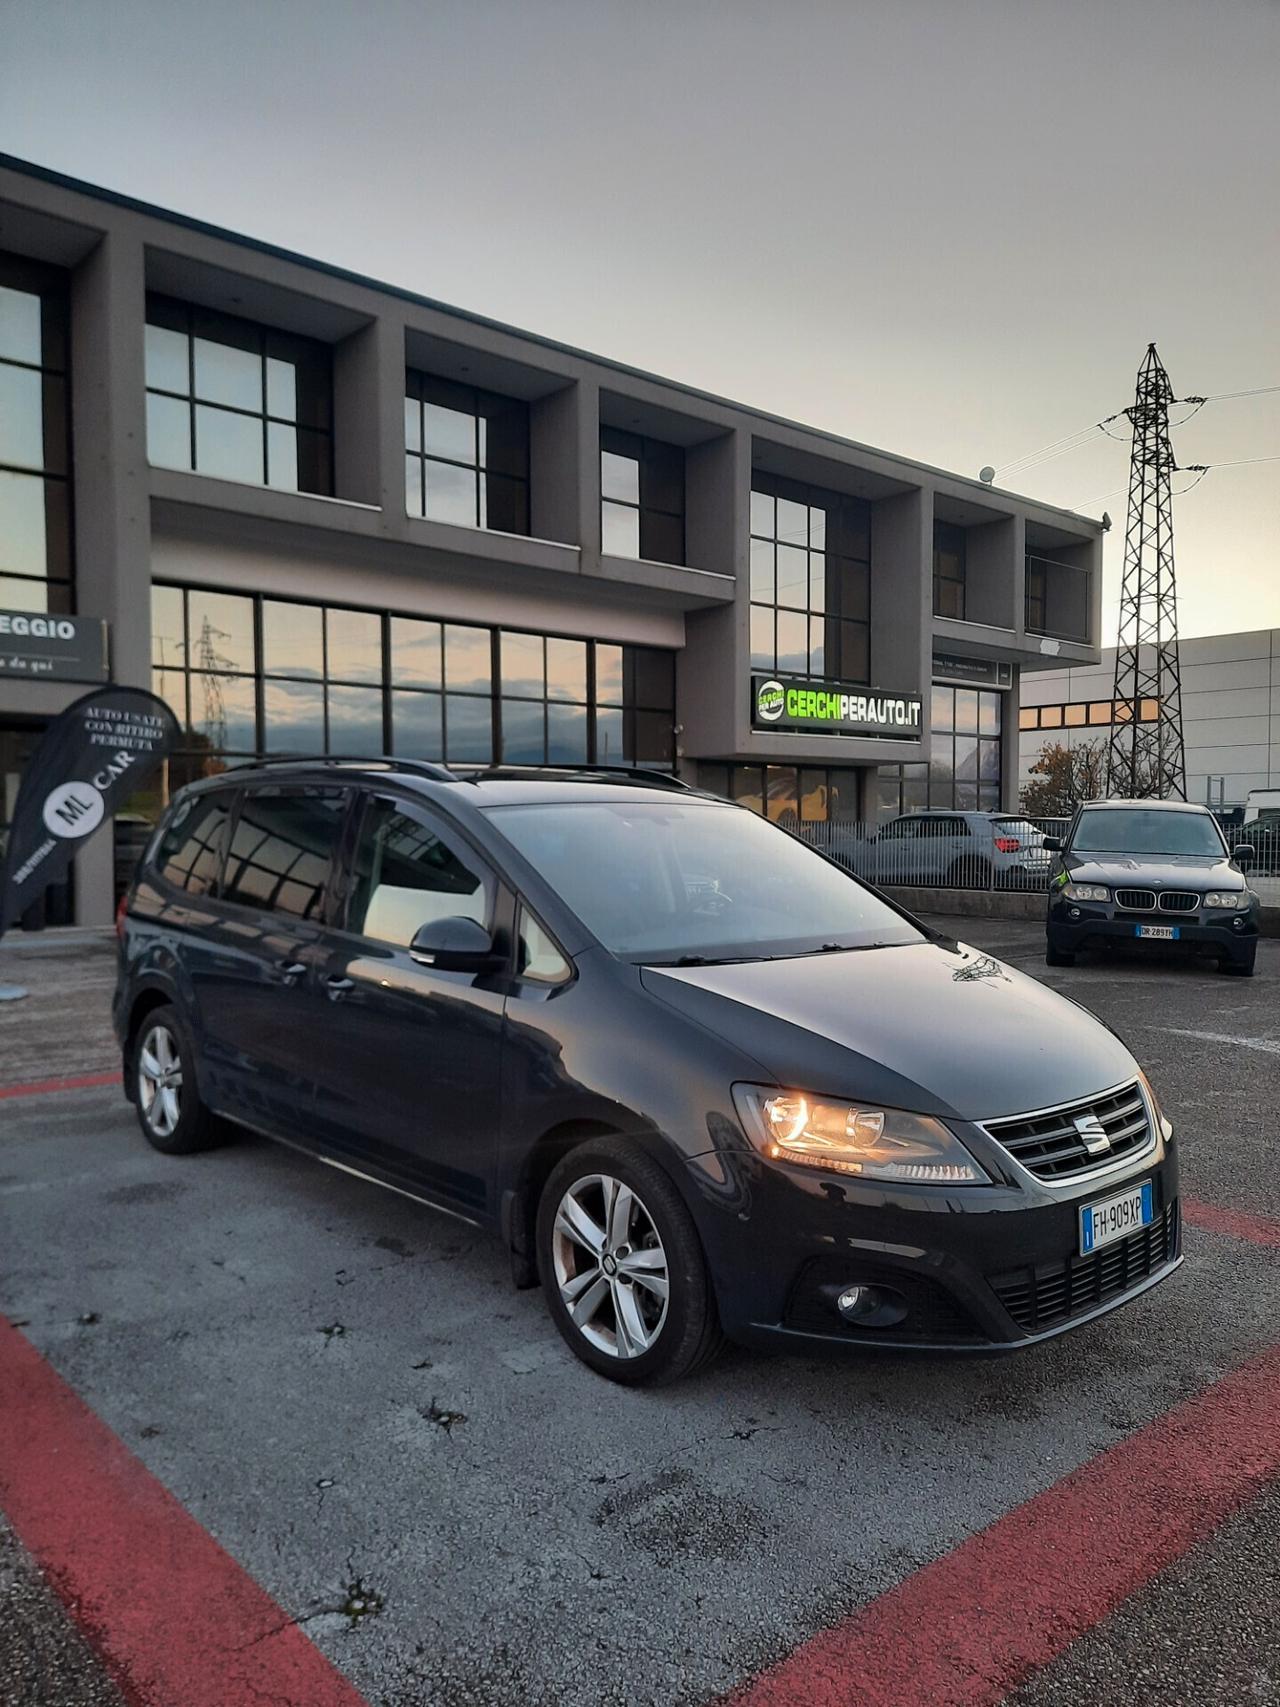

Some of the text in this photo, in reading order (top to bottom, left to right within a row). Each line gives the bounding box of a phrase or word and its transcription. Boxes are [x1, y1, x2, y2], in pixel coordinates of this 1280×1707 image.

[84, 706, 122, 721] AUTO
[787, 688, 921, 726] CERCHIPERAUTO.IT
[84, 720, 163, 739] CON RITIRO
[90, 733, 153, 751] PERMUTA
[55, 751, 135, 826] ML CAR
